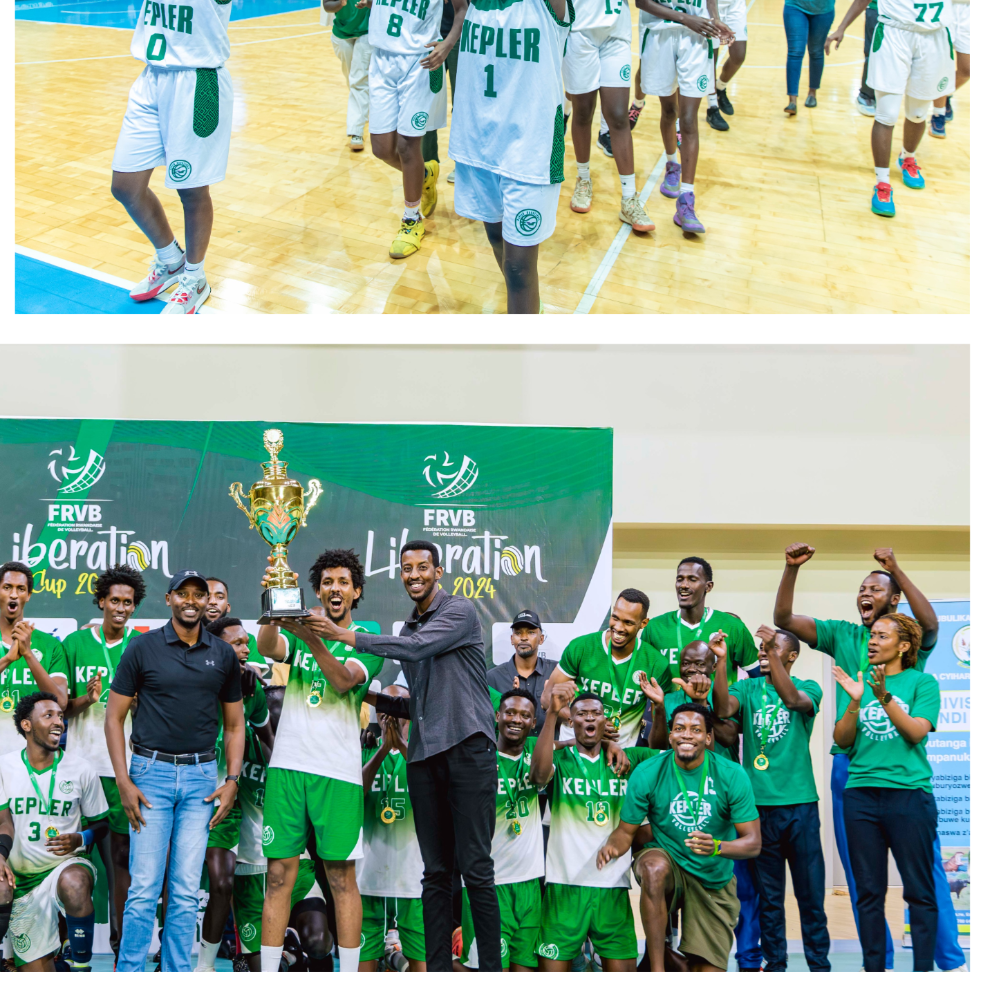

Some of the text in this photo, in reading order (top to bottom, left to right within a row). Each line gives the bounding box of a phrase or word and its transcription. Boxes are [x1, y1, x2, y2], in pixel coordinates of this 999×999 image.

[914, 1, 944, 23] 77
[386, 13, 403, 38] 8
[146, 33, 167, 61] 0
[460, 19, 541, 63] KEPLER
[484, 64, 497, 98] 1
[48, 505, 102, 522] FRVB
[423, 509, 476, 527] FRVB
[32, 569, 67, 598] Cup
[452, 576, 497, 599] 2024
[28, 821, 41, 842] 3
